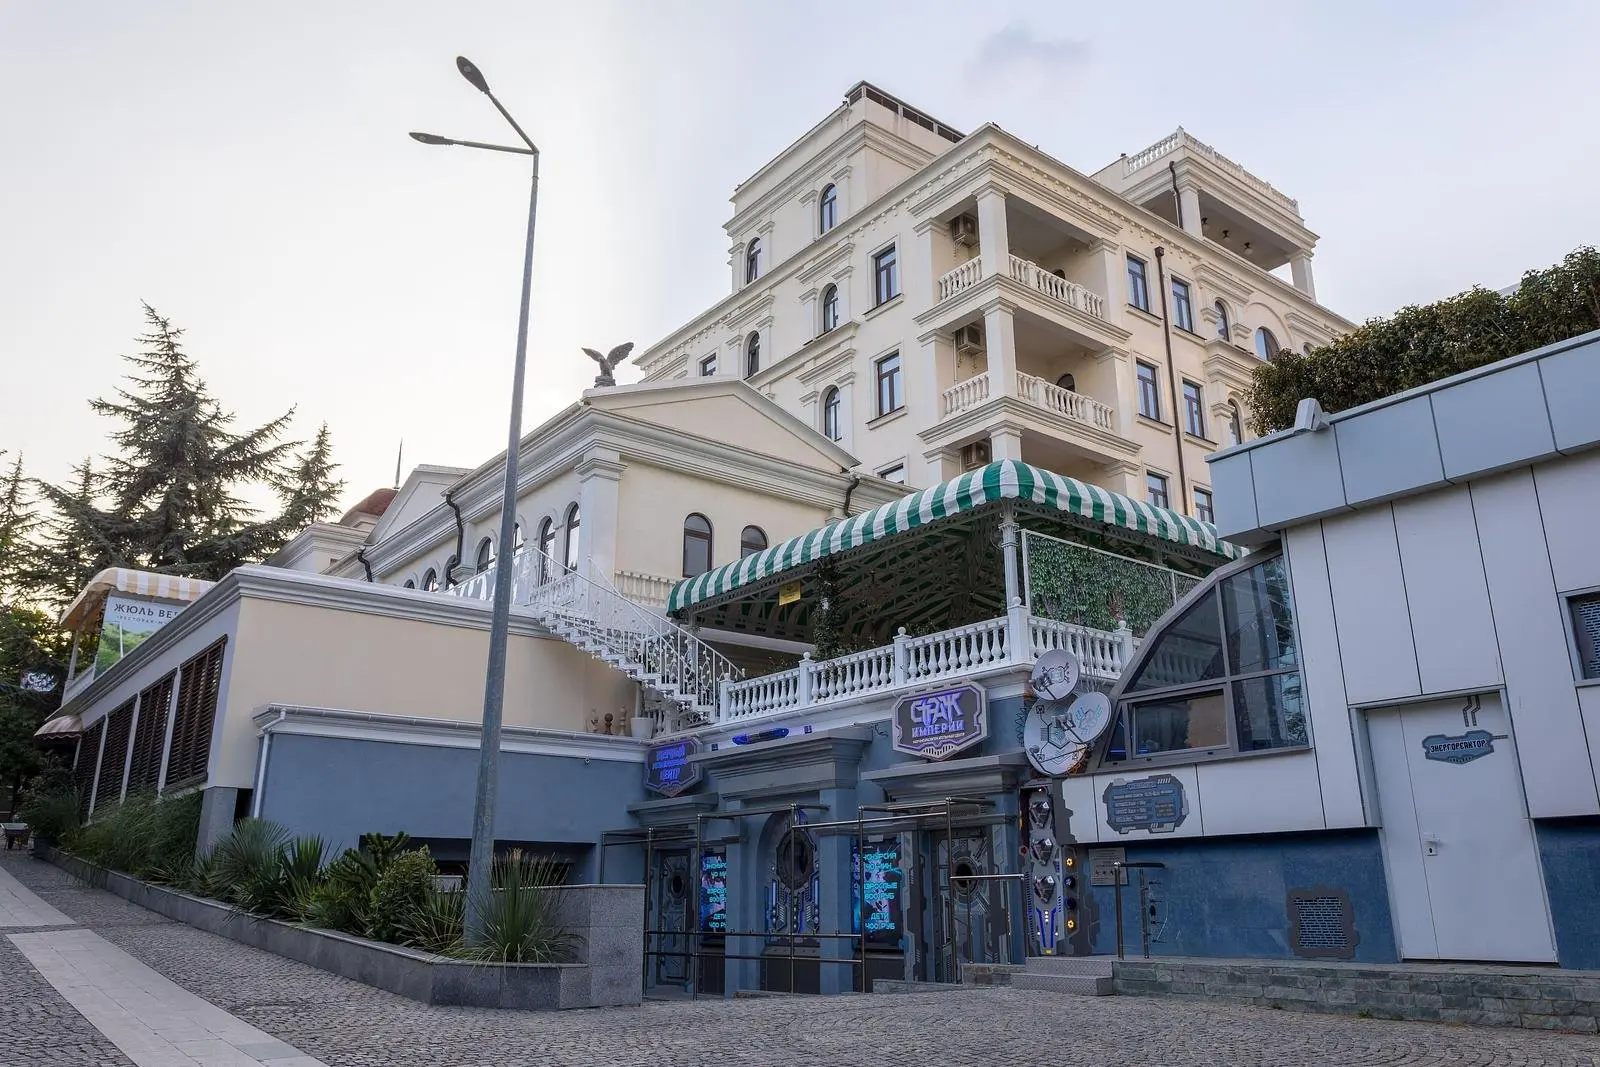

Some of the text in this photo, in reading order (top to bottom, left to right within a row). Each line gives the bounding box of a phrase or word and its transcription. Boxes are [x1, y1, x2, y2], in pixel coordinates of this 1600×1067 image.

[114, 603, 154, 617] ЖЮЛЬ
[912, 719, 965, 738] ИМПЕРИИ
[1430, 739, 1486, 754] ЭНЕРГОРЕАКТОР
[870, 912, 889, 921] ДЕТИ
